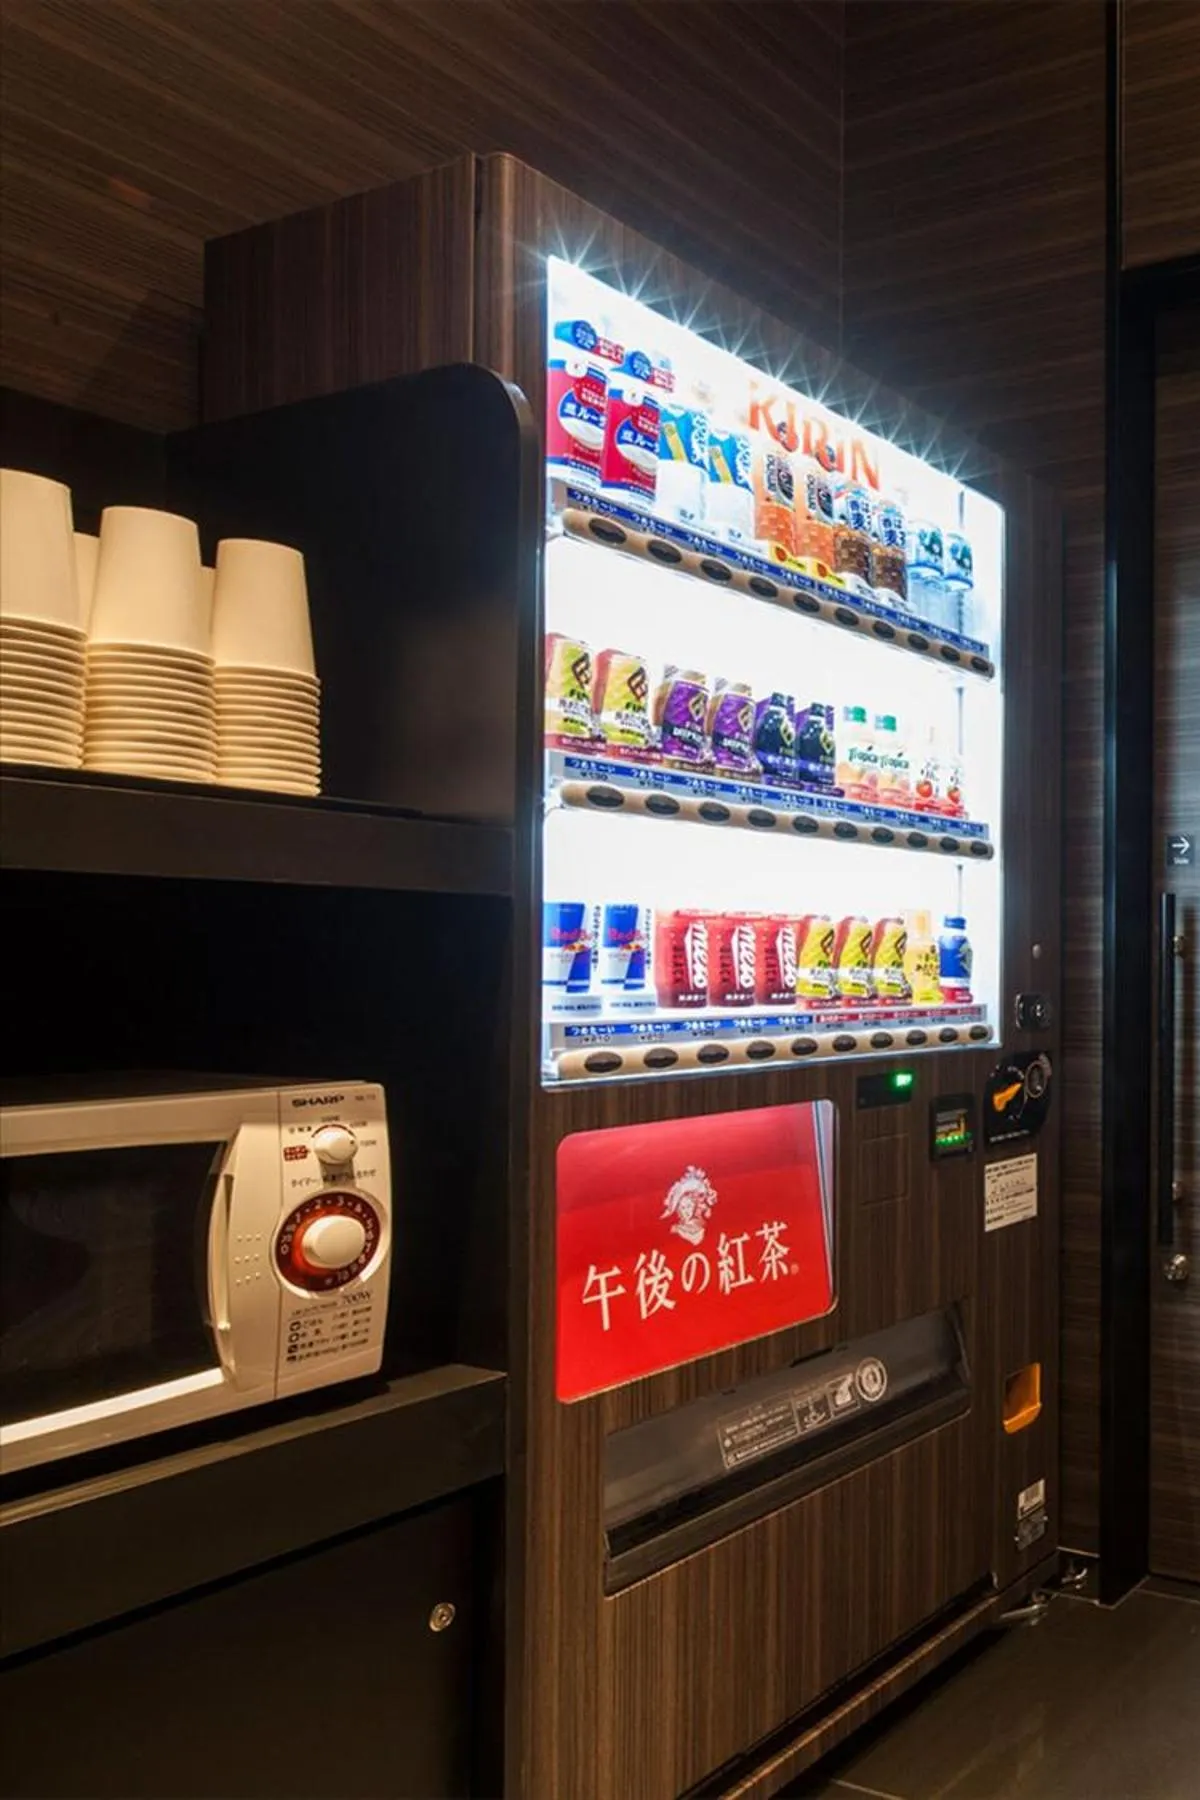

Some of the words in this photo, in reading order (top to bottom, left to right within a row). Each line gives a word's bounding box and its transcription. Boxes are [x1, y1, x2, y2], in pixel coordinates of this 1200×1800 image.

[748, 380, 881, 491] KIRIN
[291, 1095, 344, 1108] SHARP
[582, 1220, 790, 1331] 午後の紅茶
